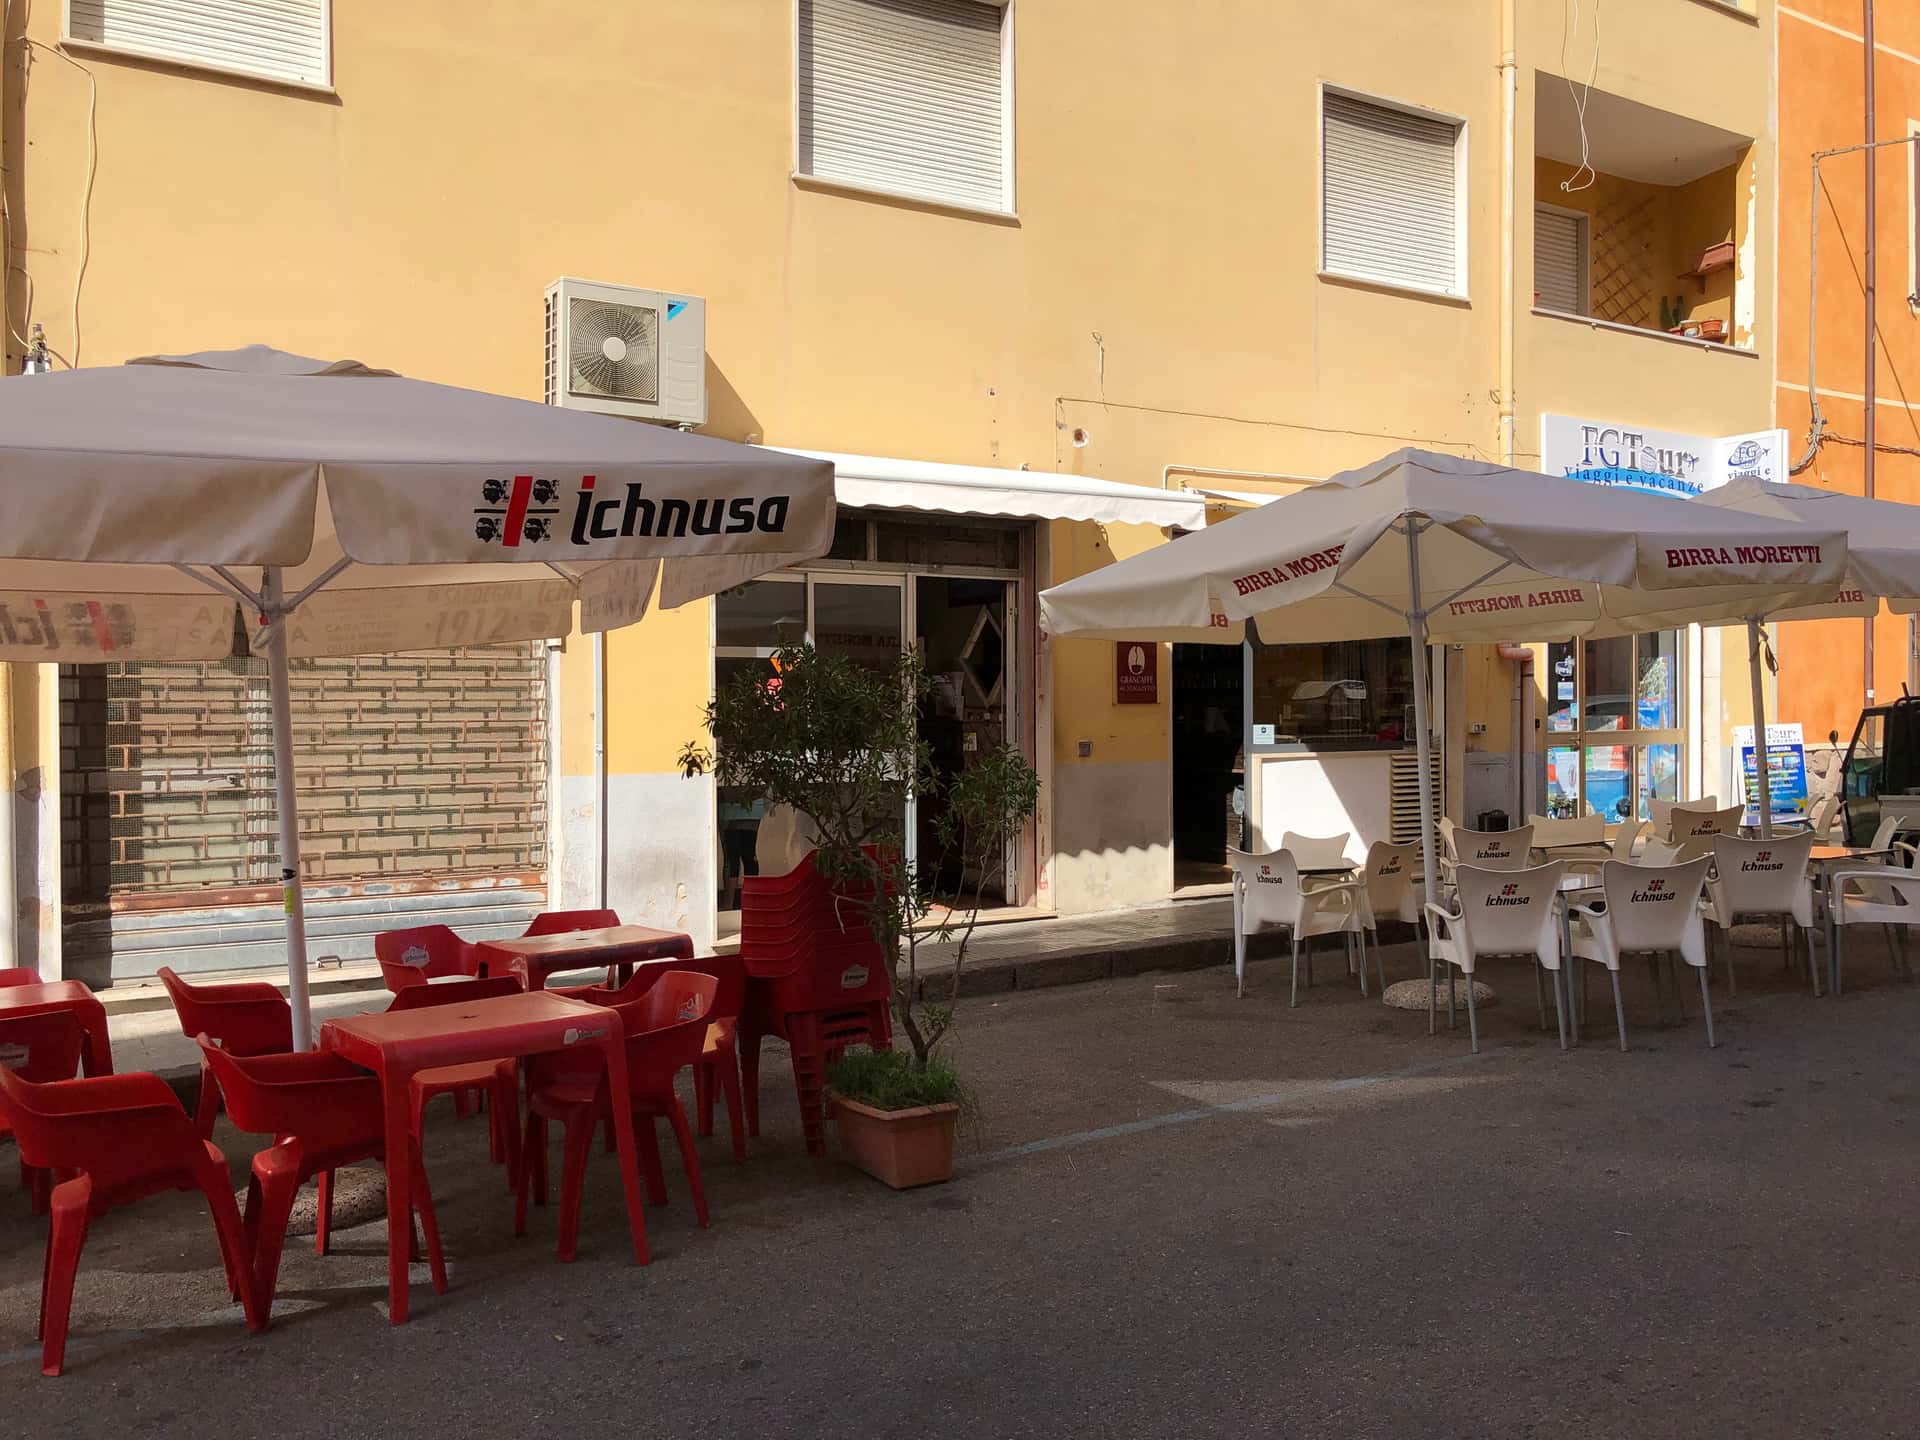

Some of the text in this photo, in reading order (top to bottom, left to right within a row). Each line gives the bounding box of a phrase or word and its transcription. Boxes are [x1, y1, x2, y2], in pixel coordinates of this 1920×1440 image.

[1563, 463, 1705, 494] viaggi e vacanze
[570, 475, 791, 547] ichnusa
[1665, 545, 1822, 568] BIRRA MORETTI
[1233, 567, 1291, 597] BIRRA
[1476, 848, 1510, 859] ichnusa
[1740, 861, 1784, 873] ichnusa
[1486, 894, 1530, 907] ichnusa
[1630, 889, 1676, 904] ichnusa
